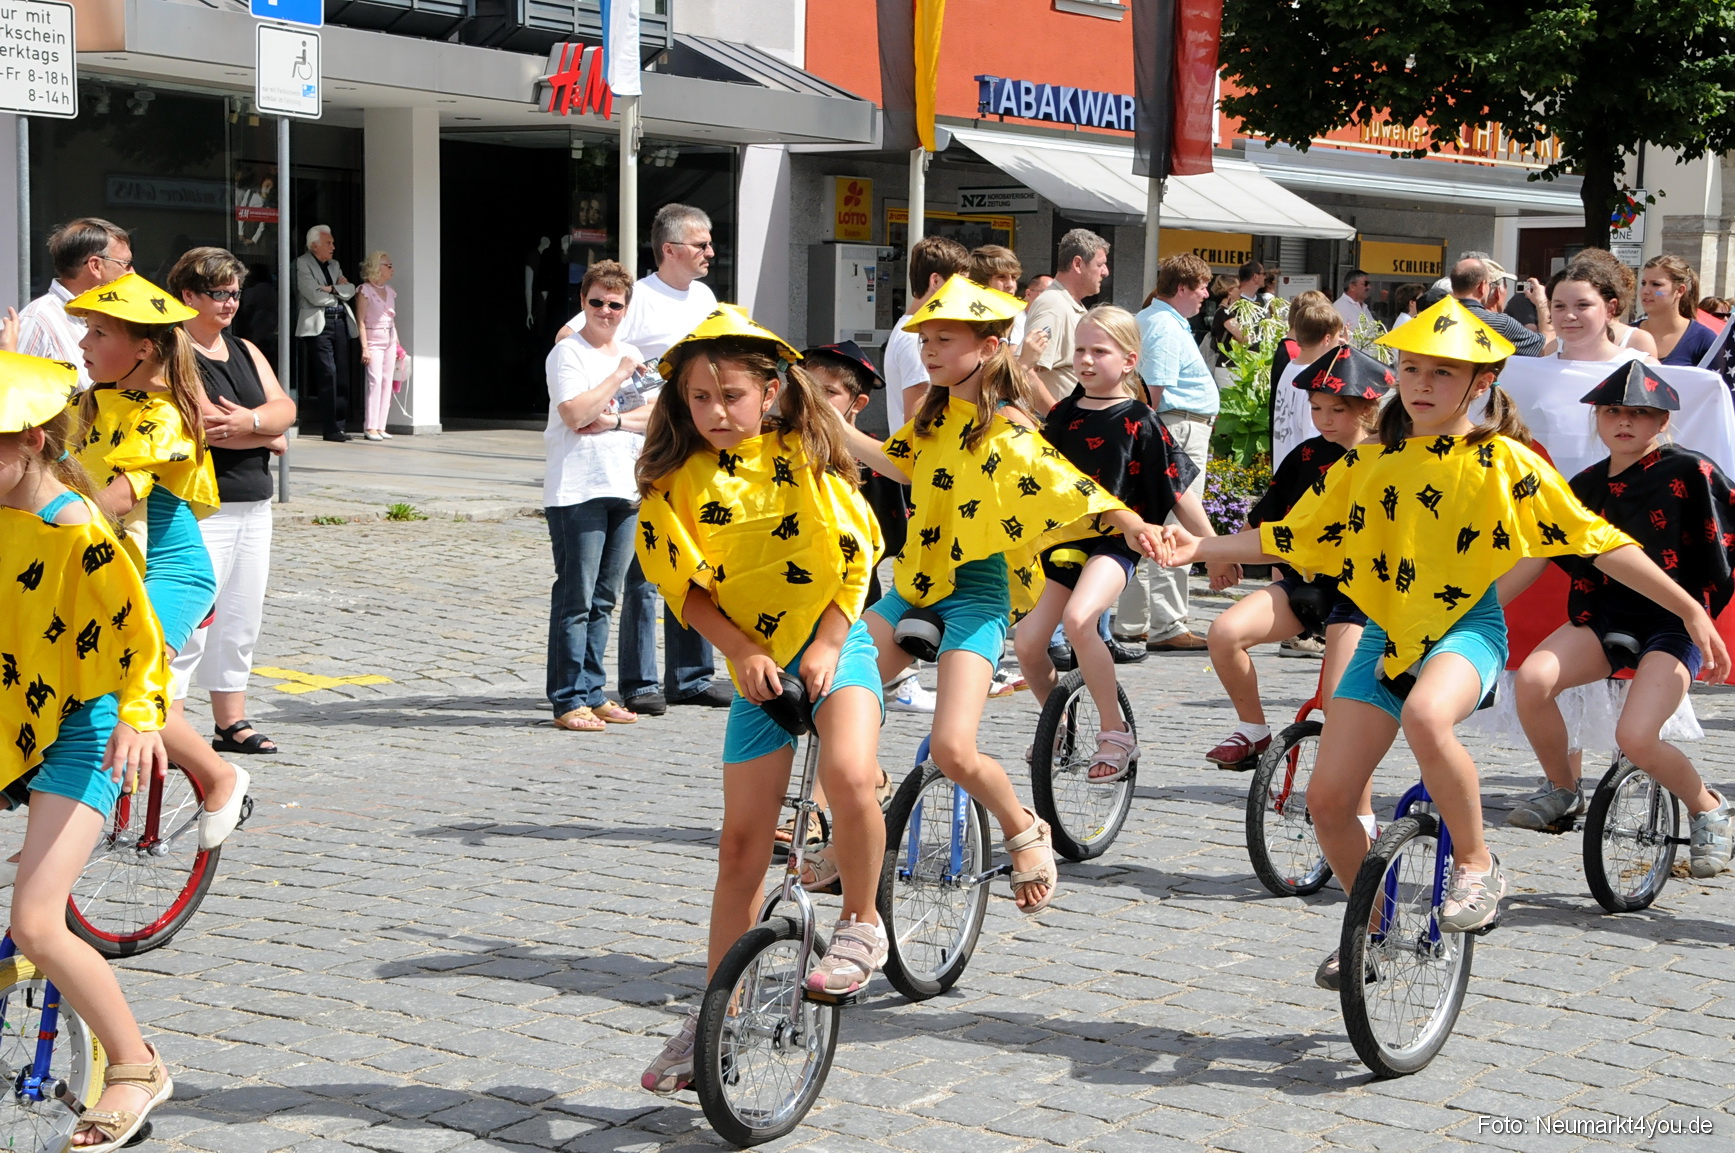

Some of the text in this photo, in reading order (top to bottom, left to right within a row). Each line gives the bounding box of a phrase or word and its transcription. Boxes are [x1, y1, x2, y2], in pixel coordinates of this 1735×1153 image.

[26, 9, 51, 24] mit
[0, 44, 59, 65] erktags
[545, 42, 613, 120] H&M
[961, 194, 987, 208] NZ
[987, 192, 1035, 200] NORDBAYERISCHE
[838, 211, 867, 226] LOTTO
[1609, 231, 1632, 240] ONE
